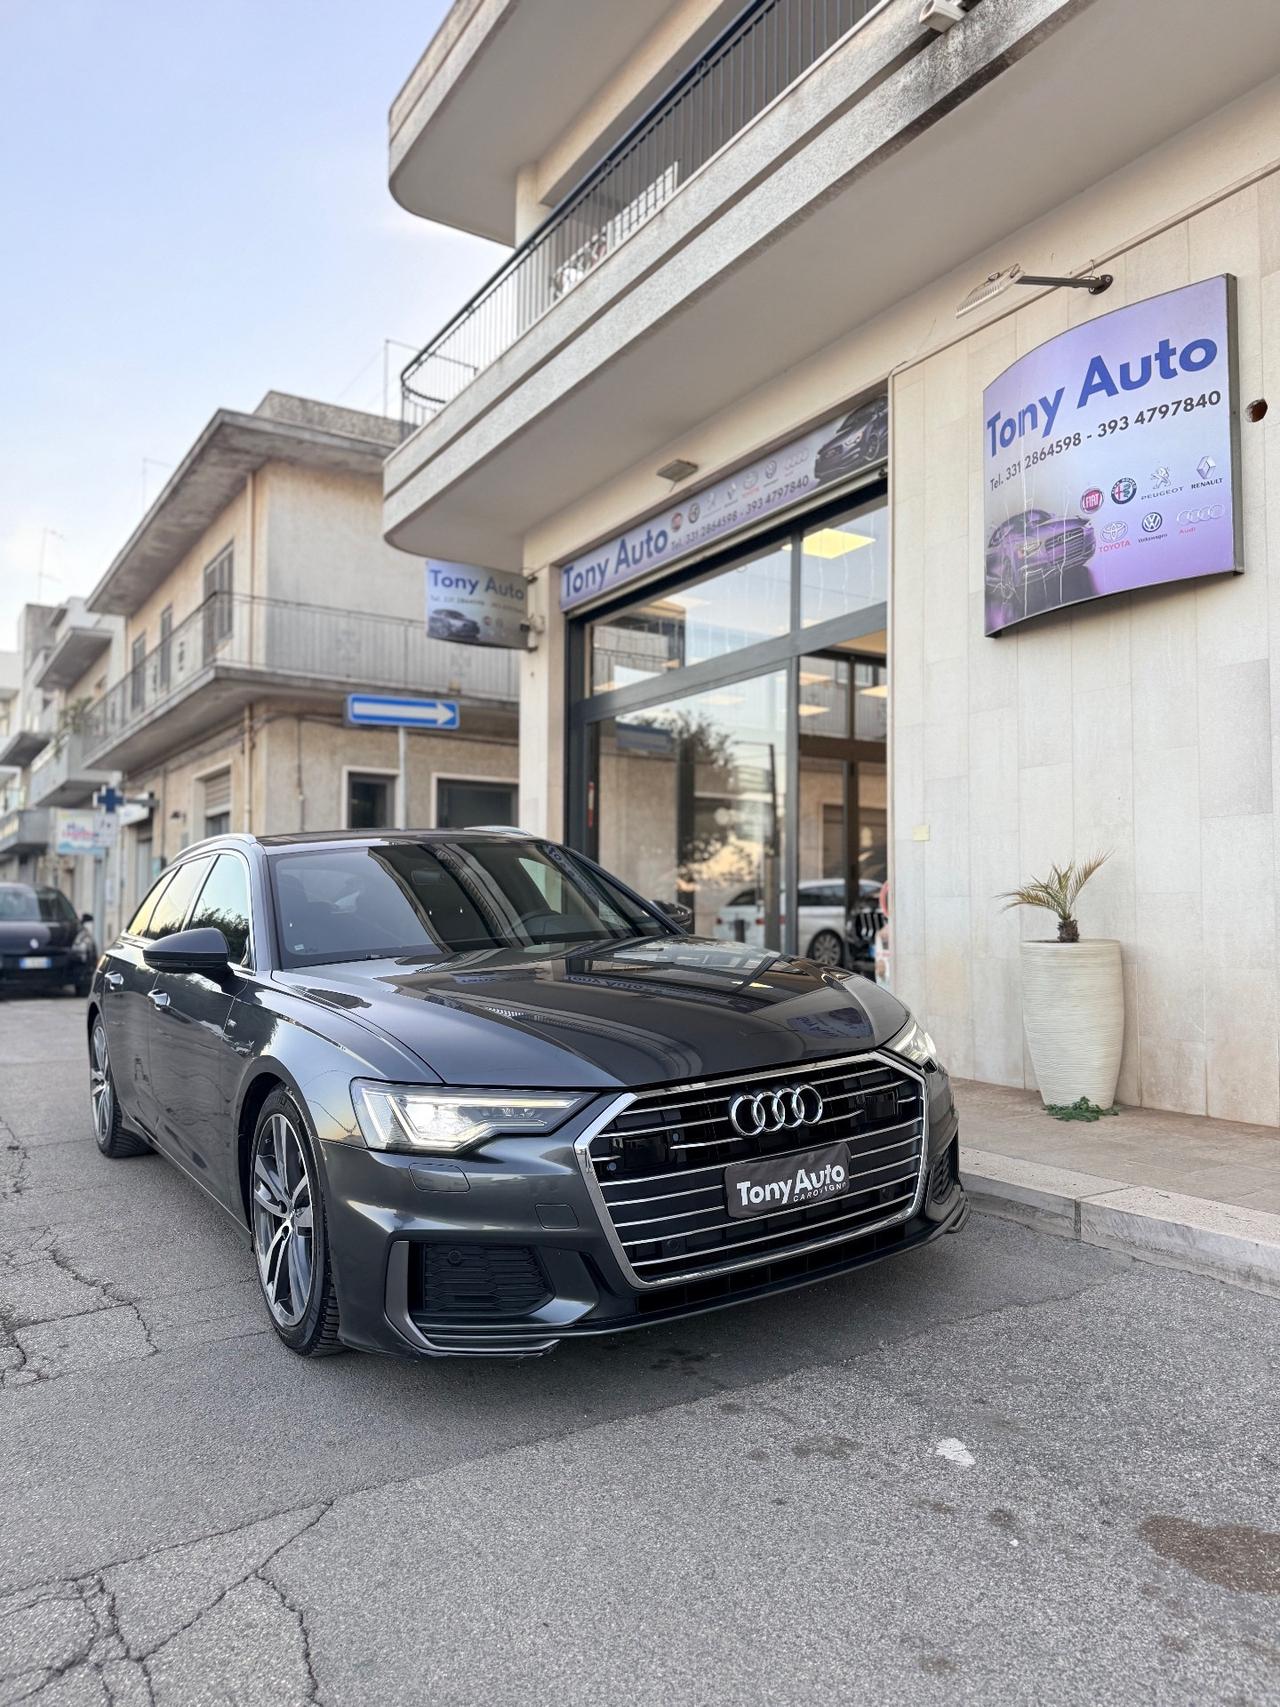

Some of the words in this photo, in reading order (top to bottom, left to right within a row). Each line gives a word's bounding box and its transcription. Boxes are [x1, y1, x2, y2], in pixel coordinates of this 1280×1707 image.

[987, 387, 1066, 457] Tony
[1077, 338, 1218, 408] Auto
[990, 469, 1004, 491] Tel.
[1006, 458, 1021, 482] 331
[1024, 432, 1081, 469] 2864598
[1098, 416, 1129, 439] 393
[1135, 390, 1221, 425] 4797840
[746, 499, 764, 518] 393
[766, 475, 809, 505] 4797840
[1141, 486, 1184, 501] PEUGEOT
[1191, 477, 1223, 490] RENAULT
[1098, 540, 1131, 553] TOYOTA
[1179, 527, 1196, 535] Audi
[563, 557, 609, 599] Tony
[615, 527, 668, 575] Auto
[430, 569, 479, 595] Tony
[485, 576, 525, 600] Auto
